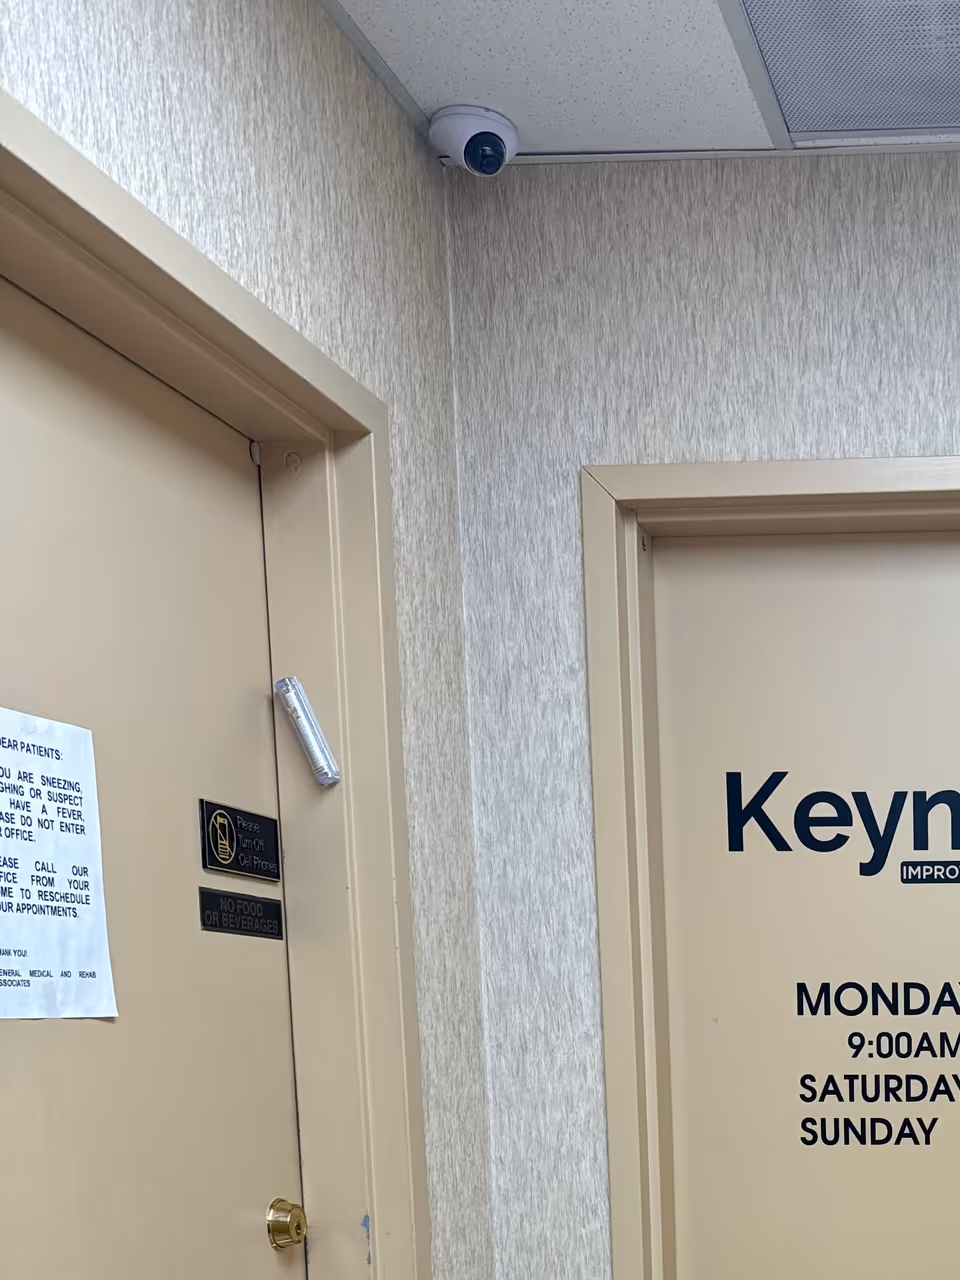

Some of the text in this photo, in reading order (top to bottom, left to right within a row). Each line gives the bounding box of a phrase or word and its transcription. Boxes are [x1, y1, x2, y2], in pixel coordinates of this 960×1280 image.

[20, 741, 63, 760] PATIENTS:
[18, 770, 34, 784] ARE
[41, 775, 82, 794] SNEEZING,
[30, 788, 42, 800] OR
[48, 791, 83, 807] SUSPECT
[10, 798, 84, 823] HAVE A FEVER,
[5, 827, 36, 842] OFFICE.
[20, 815, 32, 827] DO
[38, 818, 54, 830] NOT
[60, 821, 85, 835] ENTER
[35, 861, 56, 874] CALL
[72, 865, 88, 877] OUR
[31, 875, 55, 888] FROM
[68, 879, 89, 891] YOUR
[20, 888, 31, 900] TO
[38, 890, 90, 905] RESCHEDULE
[0, 902, 79, 918] UR APPOINTMENTS.
[220, 897, 263, 917] NO FOOD
[205, 911, 279, 934] OR BEVERAGES
[800, 1117, 939, 1147] SUNDAY
